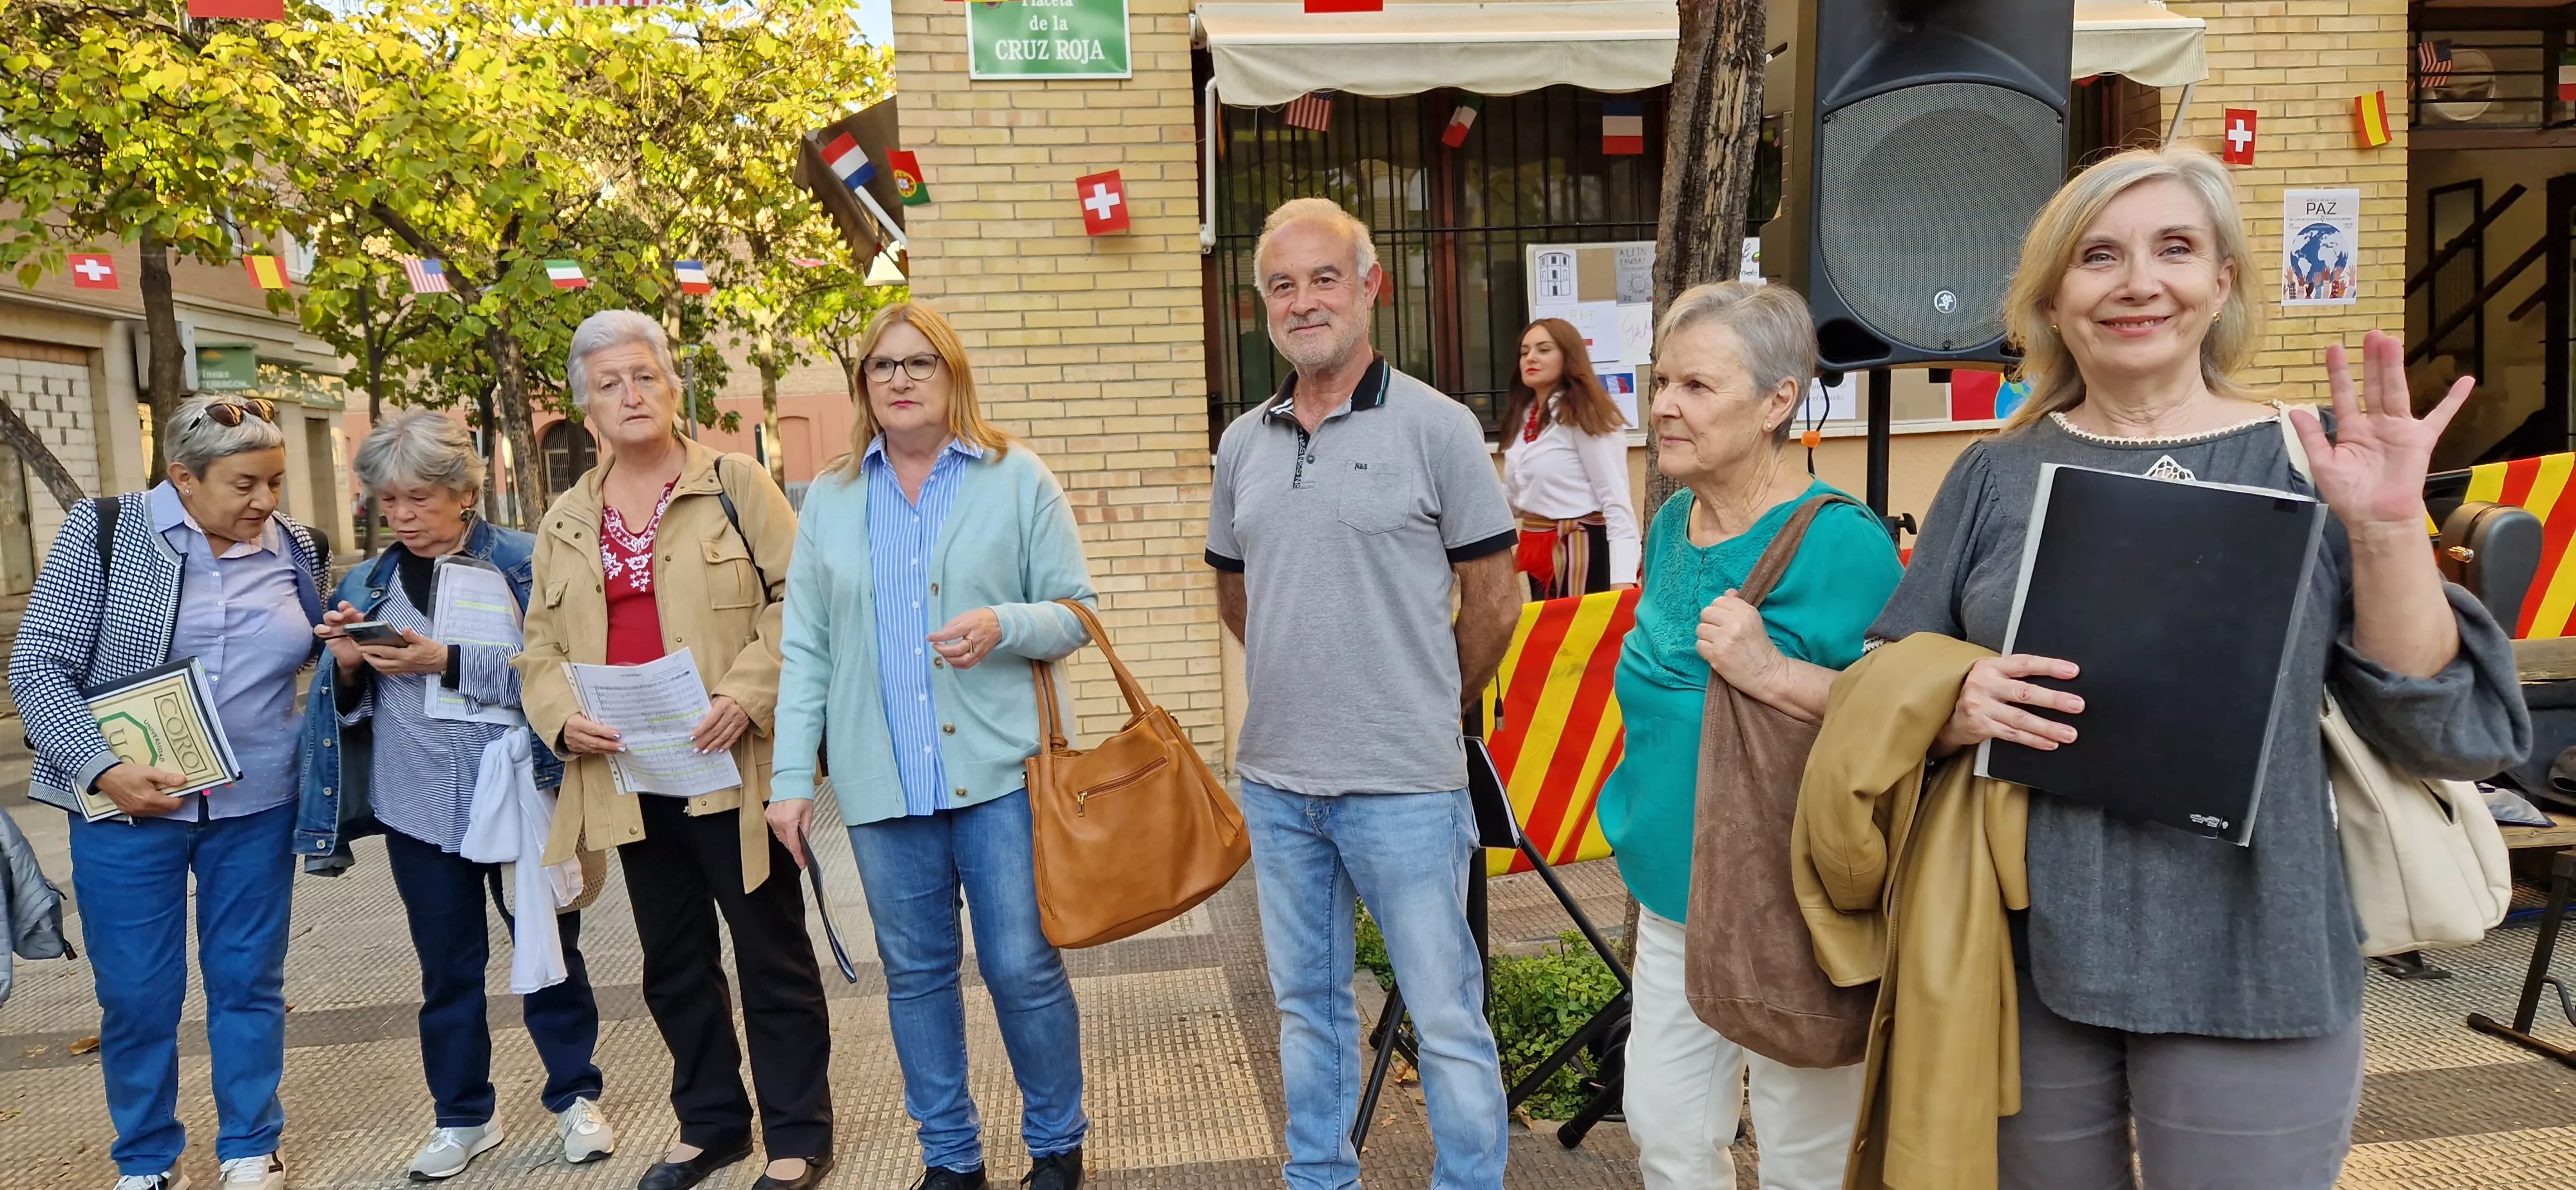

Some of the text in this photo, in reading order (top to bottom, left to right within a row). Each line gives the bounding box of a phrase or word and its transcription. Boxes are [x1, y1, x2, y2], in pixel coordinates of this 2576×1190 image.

[1030, 15, 1069, 31] de la
[995, 39, 1105, 64] CRUZ ROJA
[2306, 202, 2337, 215] PAZ
[144, 719, 165, 762] UNIVERSIDAD
[160, 697, 200, 769] CORO
